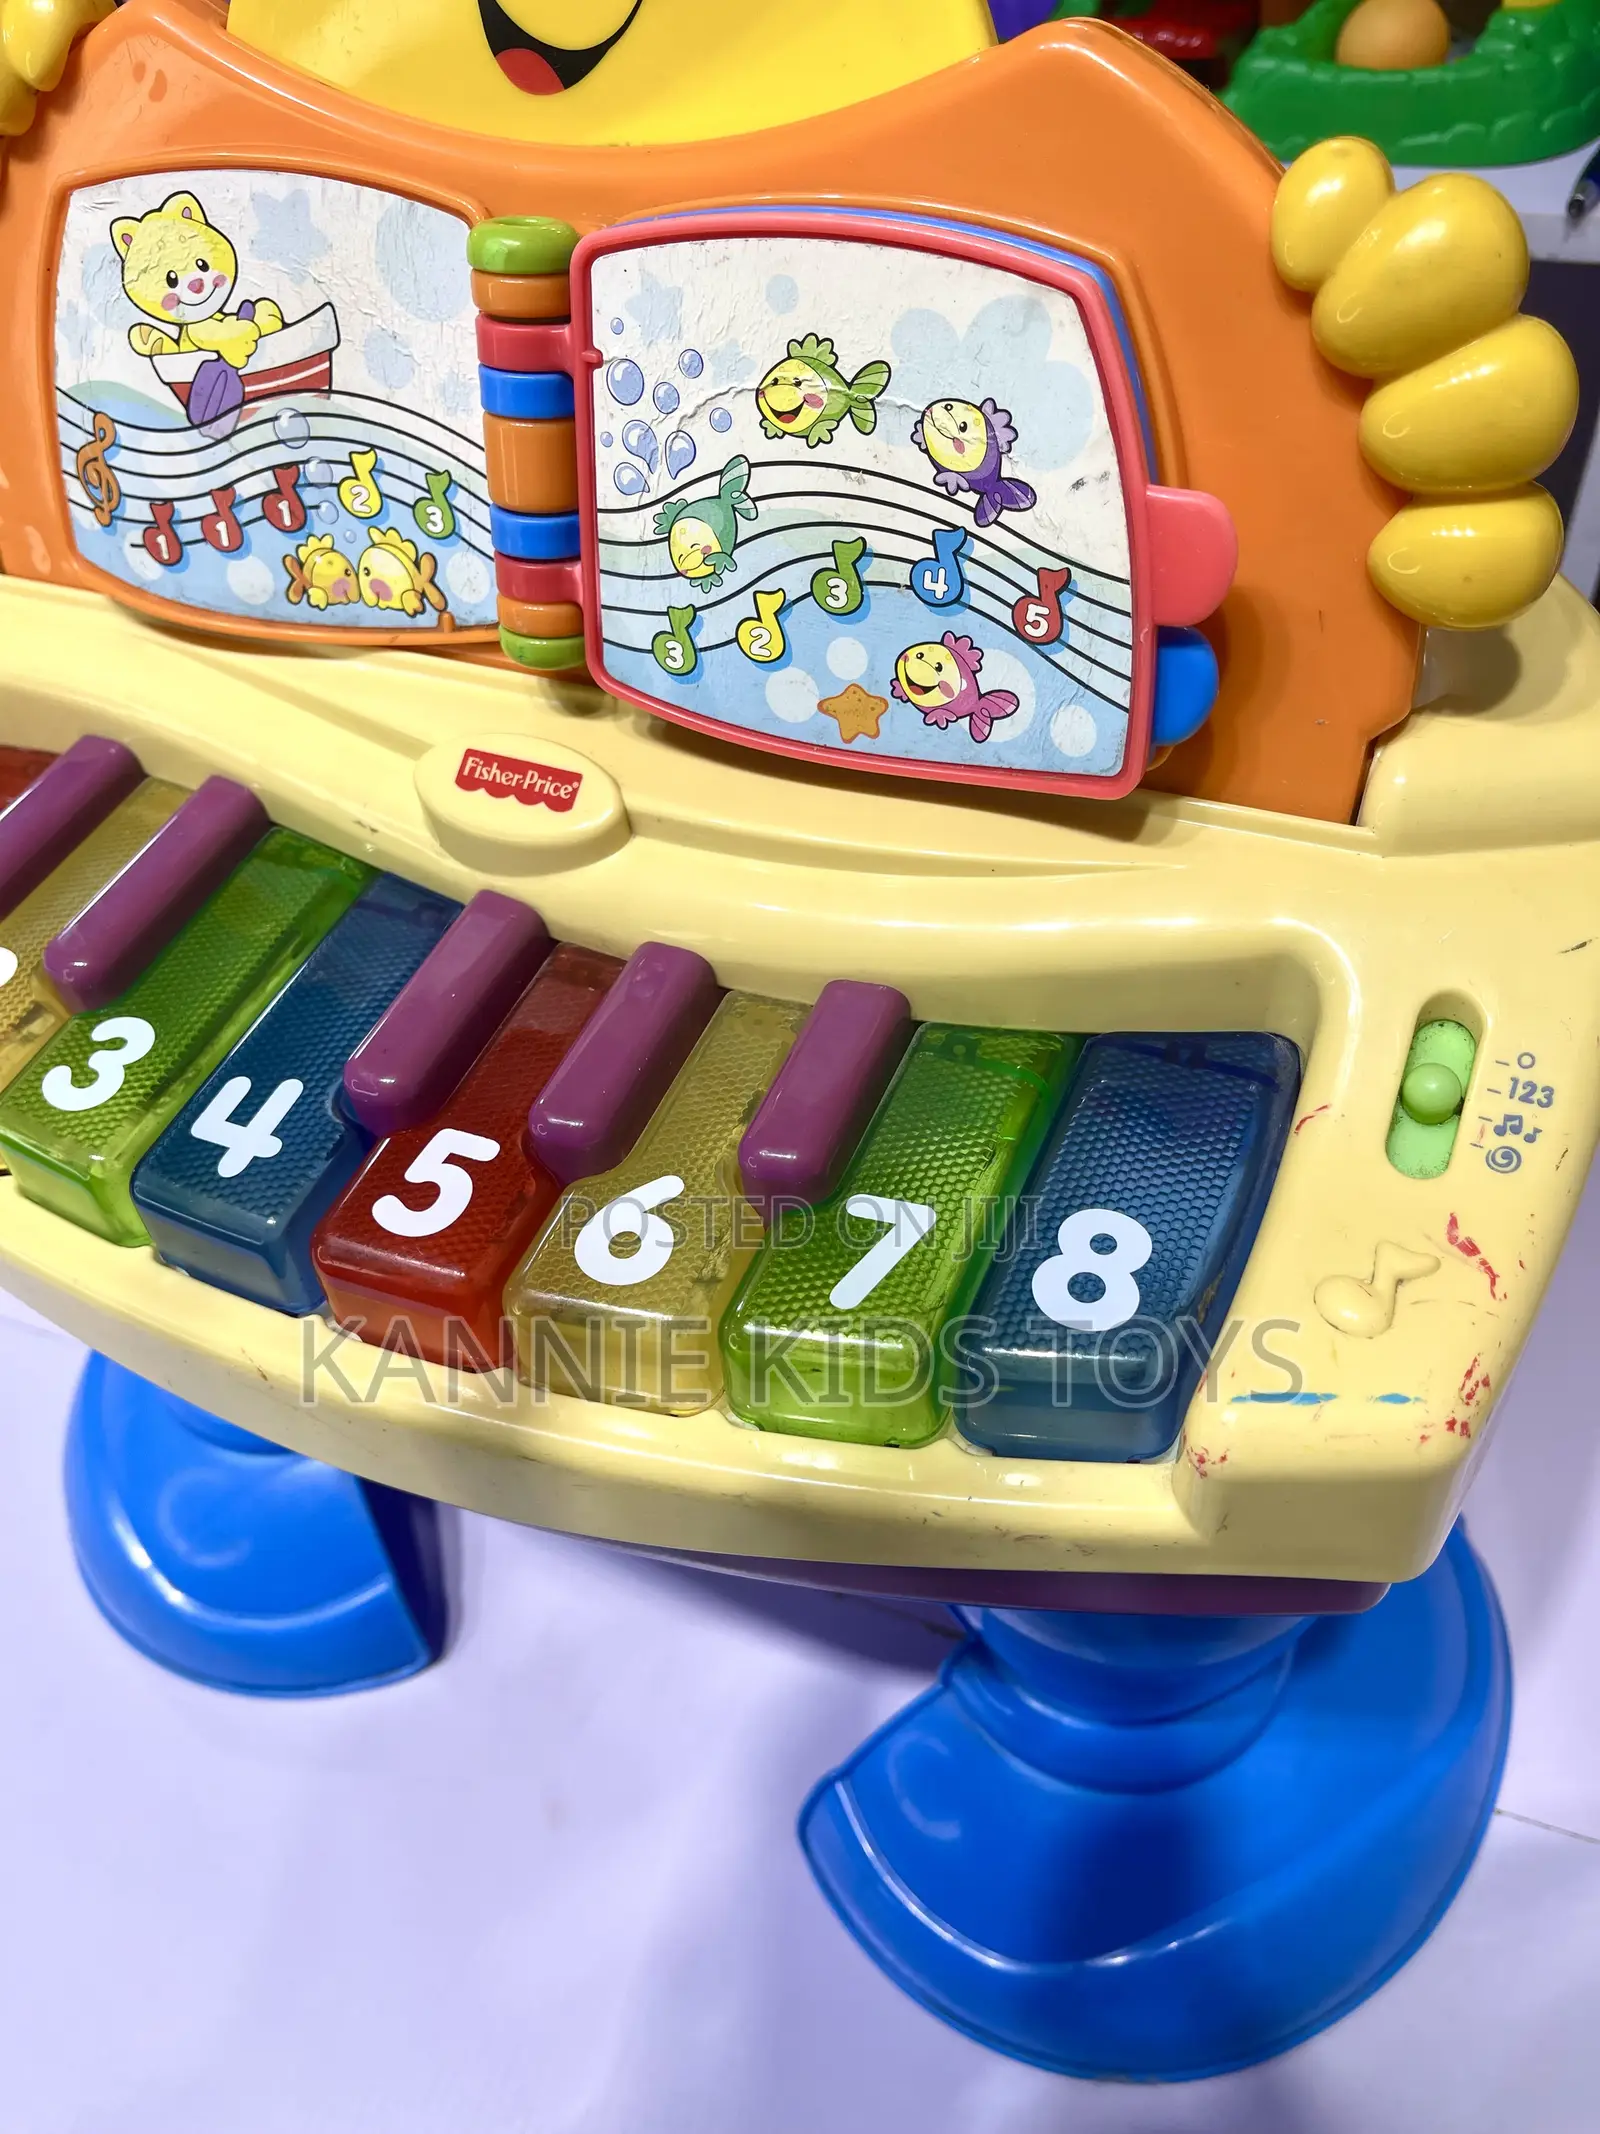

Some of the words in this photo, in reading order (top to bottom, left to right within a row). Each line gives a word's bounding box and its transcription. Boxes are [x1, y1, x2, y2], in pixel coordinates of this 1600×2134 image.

[156, 534, 171, 561] 1
[215, 520, 230, 547] 1
[277, 499, 293, 527] 1
[349, 484, 372, 513] 2
[426, 506, 444, 533] 3
[664, 639, 684, 669] 3
[749, 625, 772, 657] 2
[825, 576, 849, 609] 3
[922, 568, 949, 600] 4
[1023, 604, 1051, 638] 5
[42, 1016, 156, 1111] 3
[1508, 1076, 1555, 1108] 123
[190, 1076, 303, 1178] 4
[371, 1127, 501, 1237] 5
[574, 1174, 685, 1285] 6
[829, 1194, 937, 1310] 7
[1031, 1208, 1153, 1332] 8
